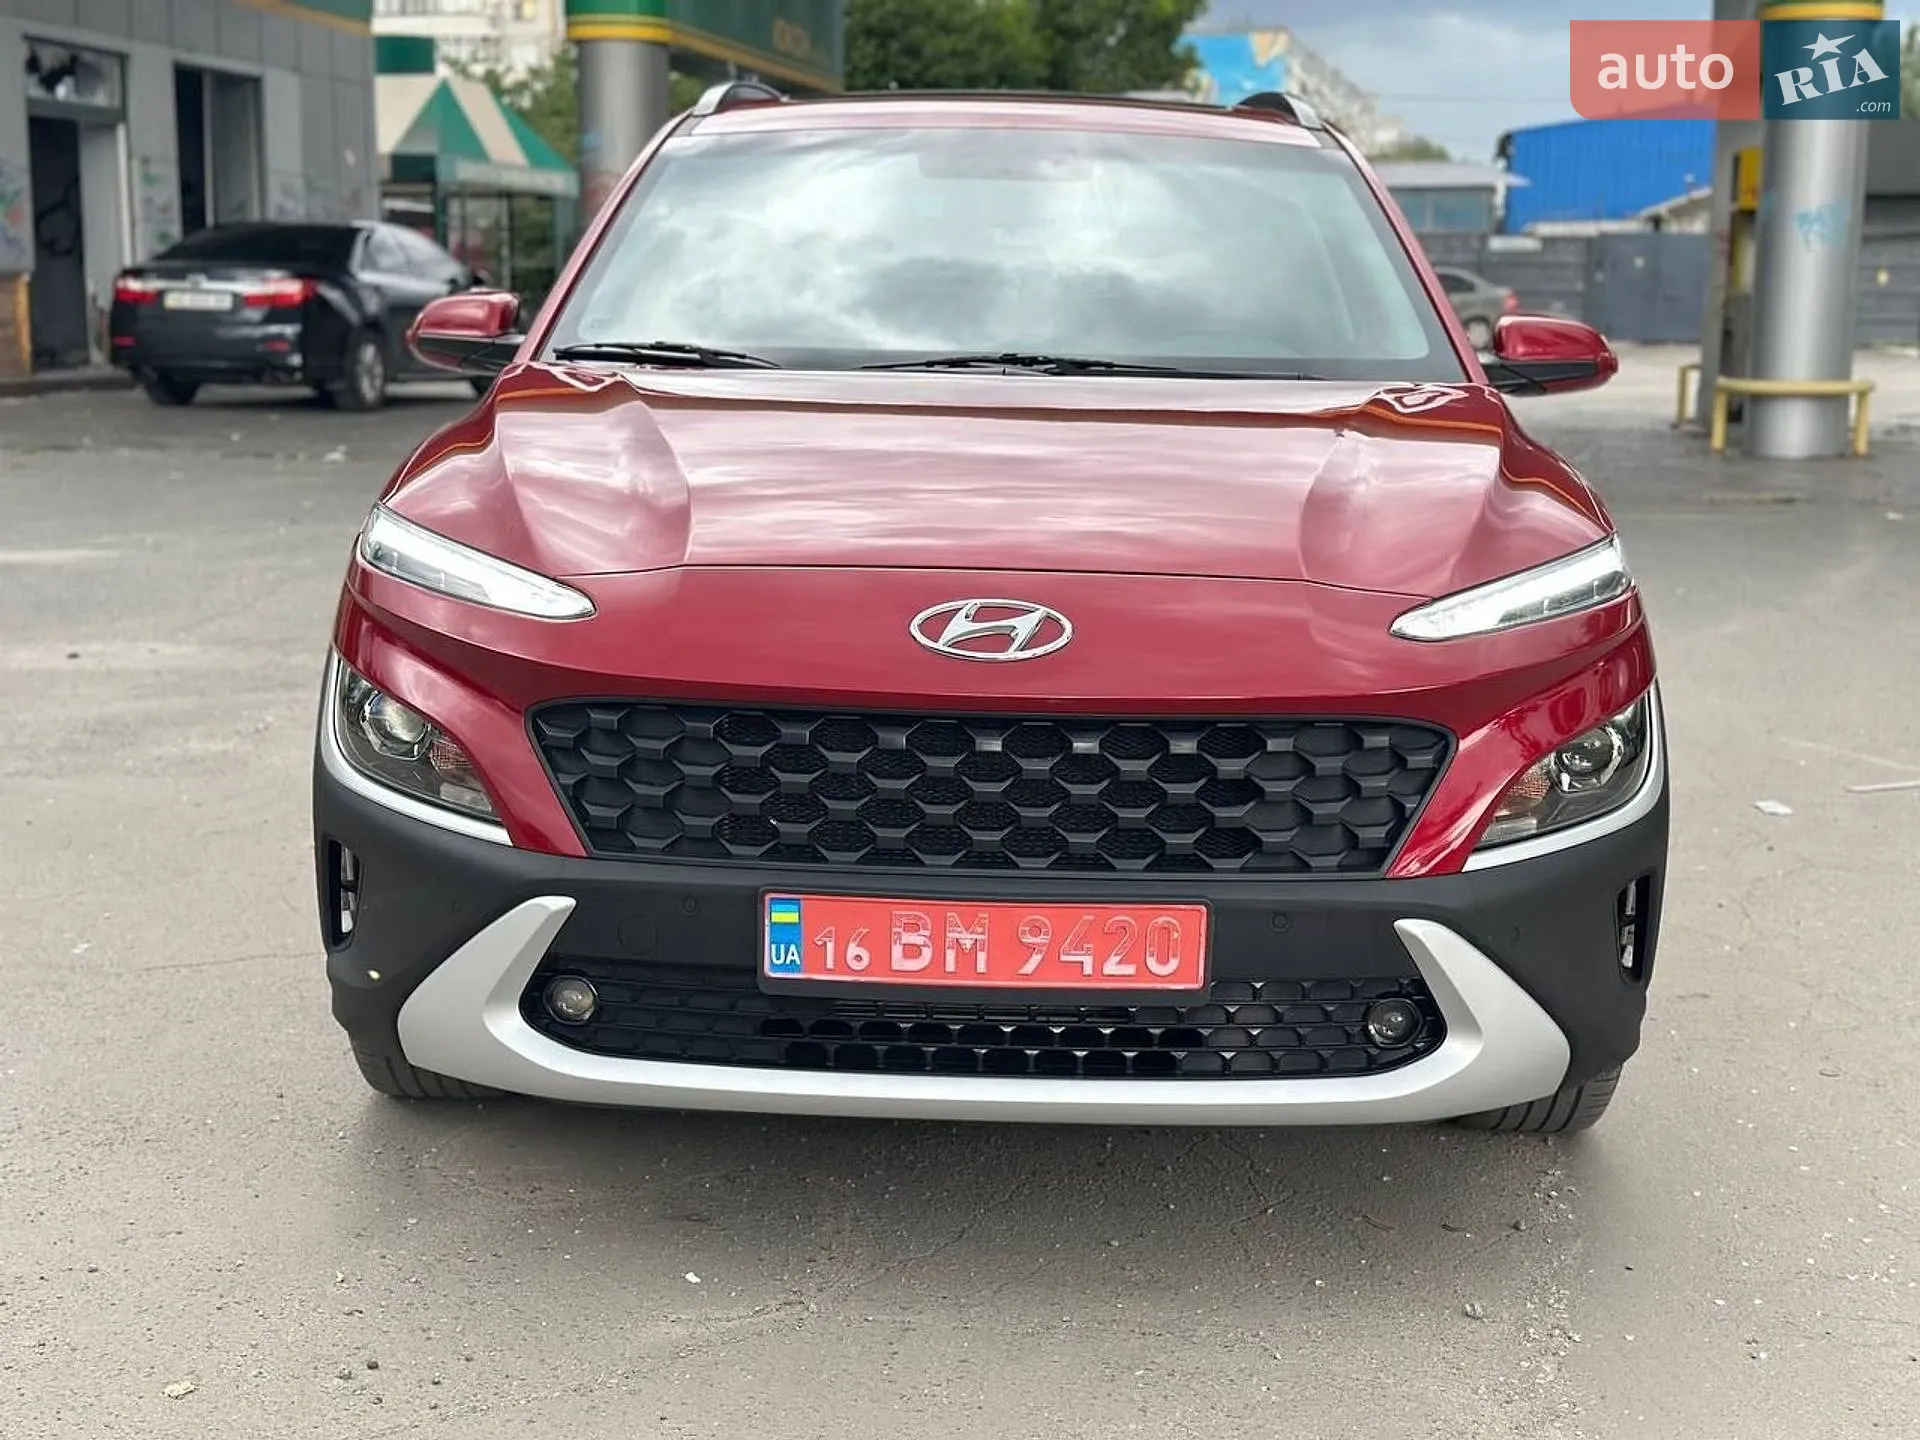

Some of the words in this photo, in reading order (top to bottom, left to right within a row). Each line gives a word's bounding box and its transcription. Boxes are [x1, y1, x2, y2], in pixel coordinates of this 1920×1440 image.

[770, 943, 800, 966] UA
[814, 926, 871, 972] 16
[891, 910, 990, 974] BM
[1017, 914, 1182, 977] 9420
